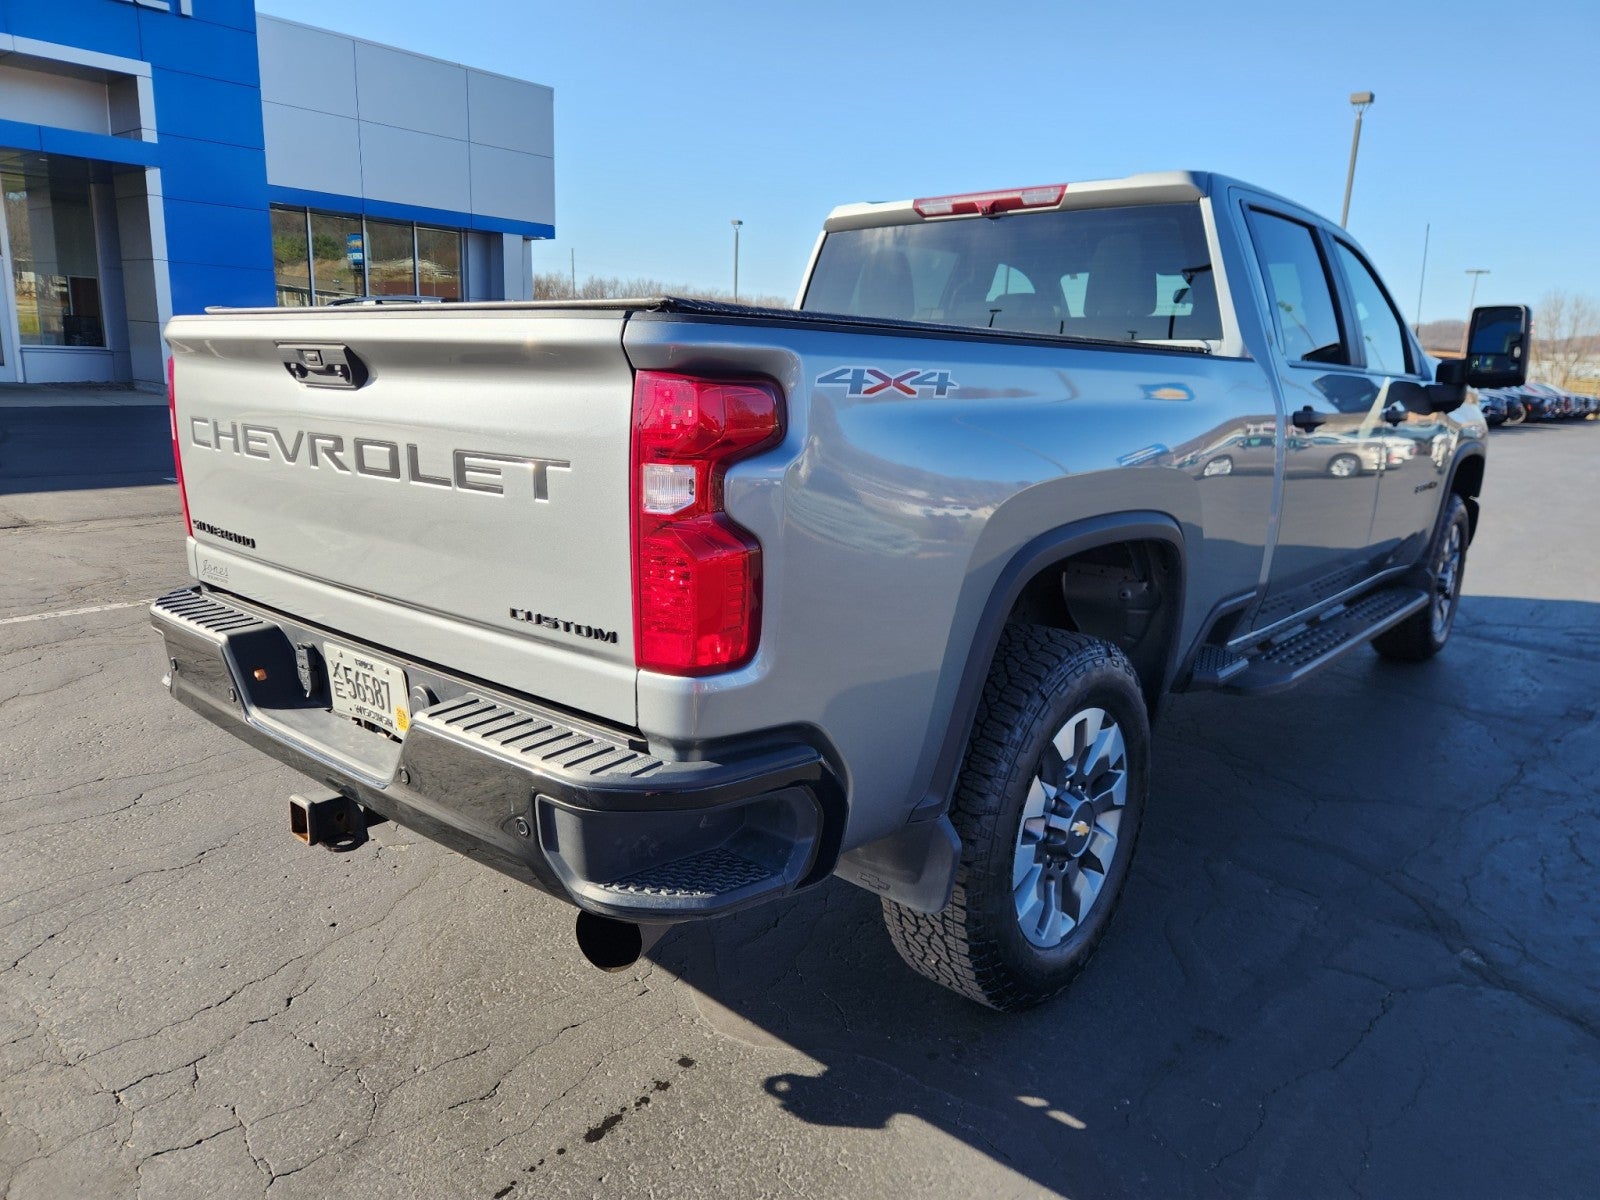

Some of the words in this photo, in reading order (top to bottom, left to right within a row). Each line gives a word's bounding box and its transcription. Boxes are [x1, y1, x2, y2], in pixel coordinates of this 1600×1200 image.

[815, 365, 959, 398] 4X4
[190, 416, 571, 503] CHEVROLET
[510, 607, 618, 644] CUSTOM
